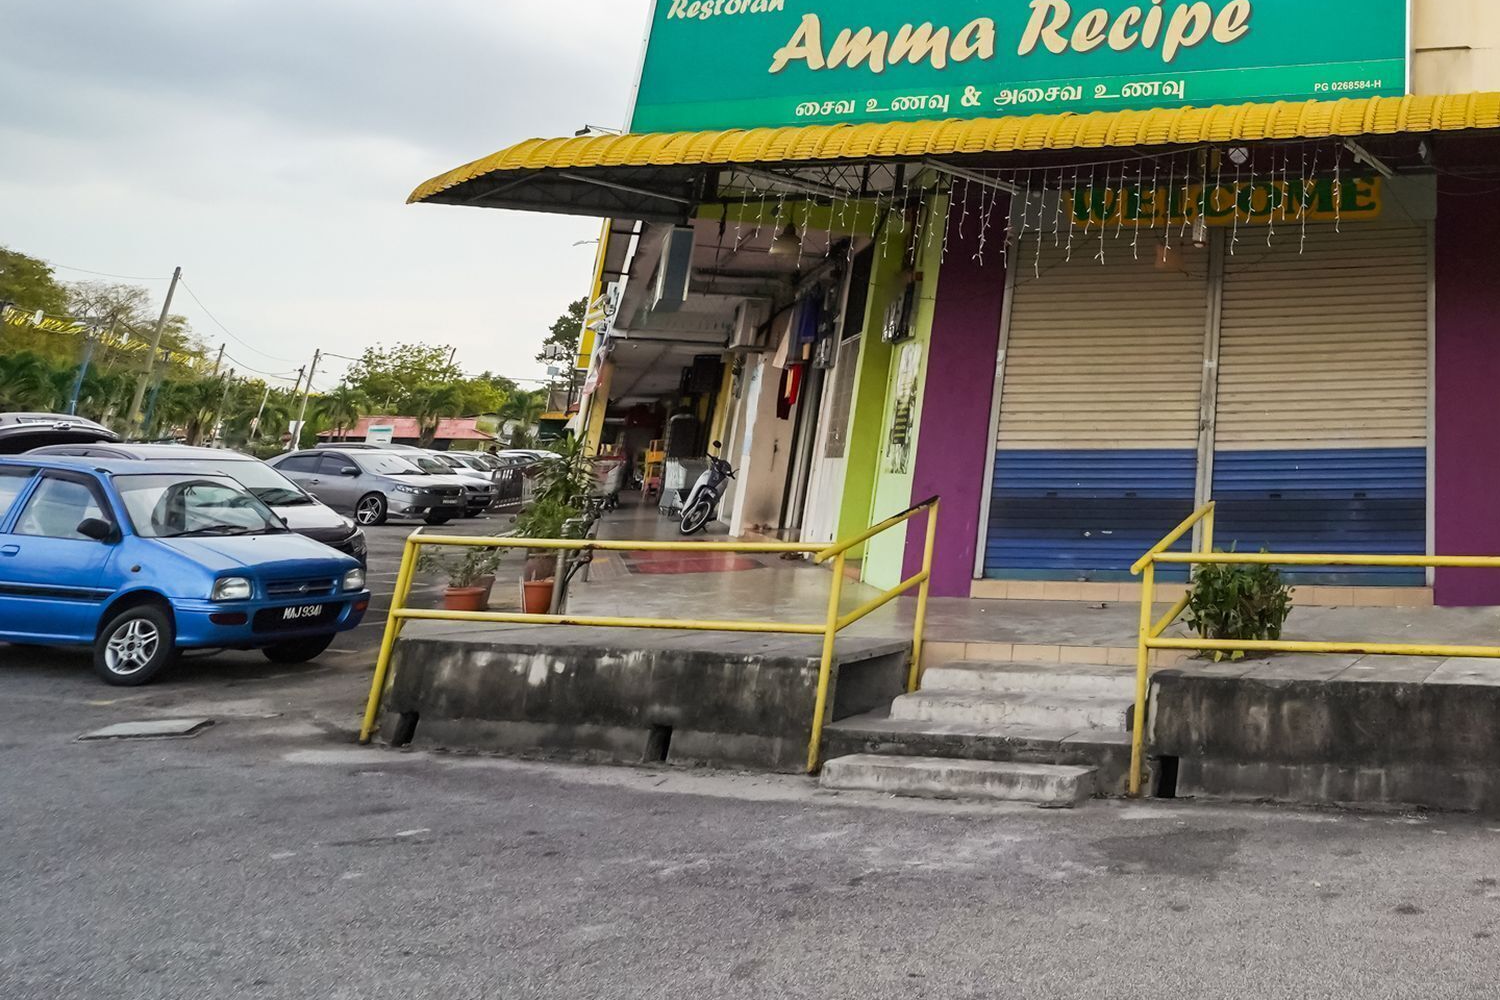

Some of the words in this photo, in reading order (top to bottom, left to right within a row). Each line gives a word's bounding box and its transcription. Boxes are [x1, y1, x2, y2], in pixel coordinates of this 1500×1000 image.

[768, 12, 996, 74] Amma
[795, 100, 856, 117] சைவ
[865, 94, 950, 113] உணவு
[960, 85, 982, 107] &
[993, 85, 1083, 106] அசைவ
[1094, 80, 1185, 100] உணவு
[1314, 82, 1329, 92] PG
[1331, 79, 1382, 91] 0268584-H
[1070, 175, 1377, 220] WELCOME
